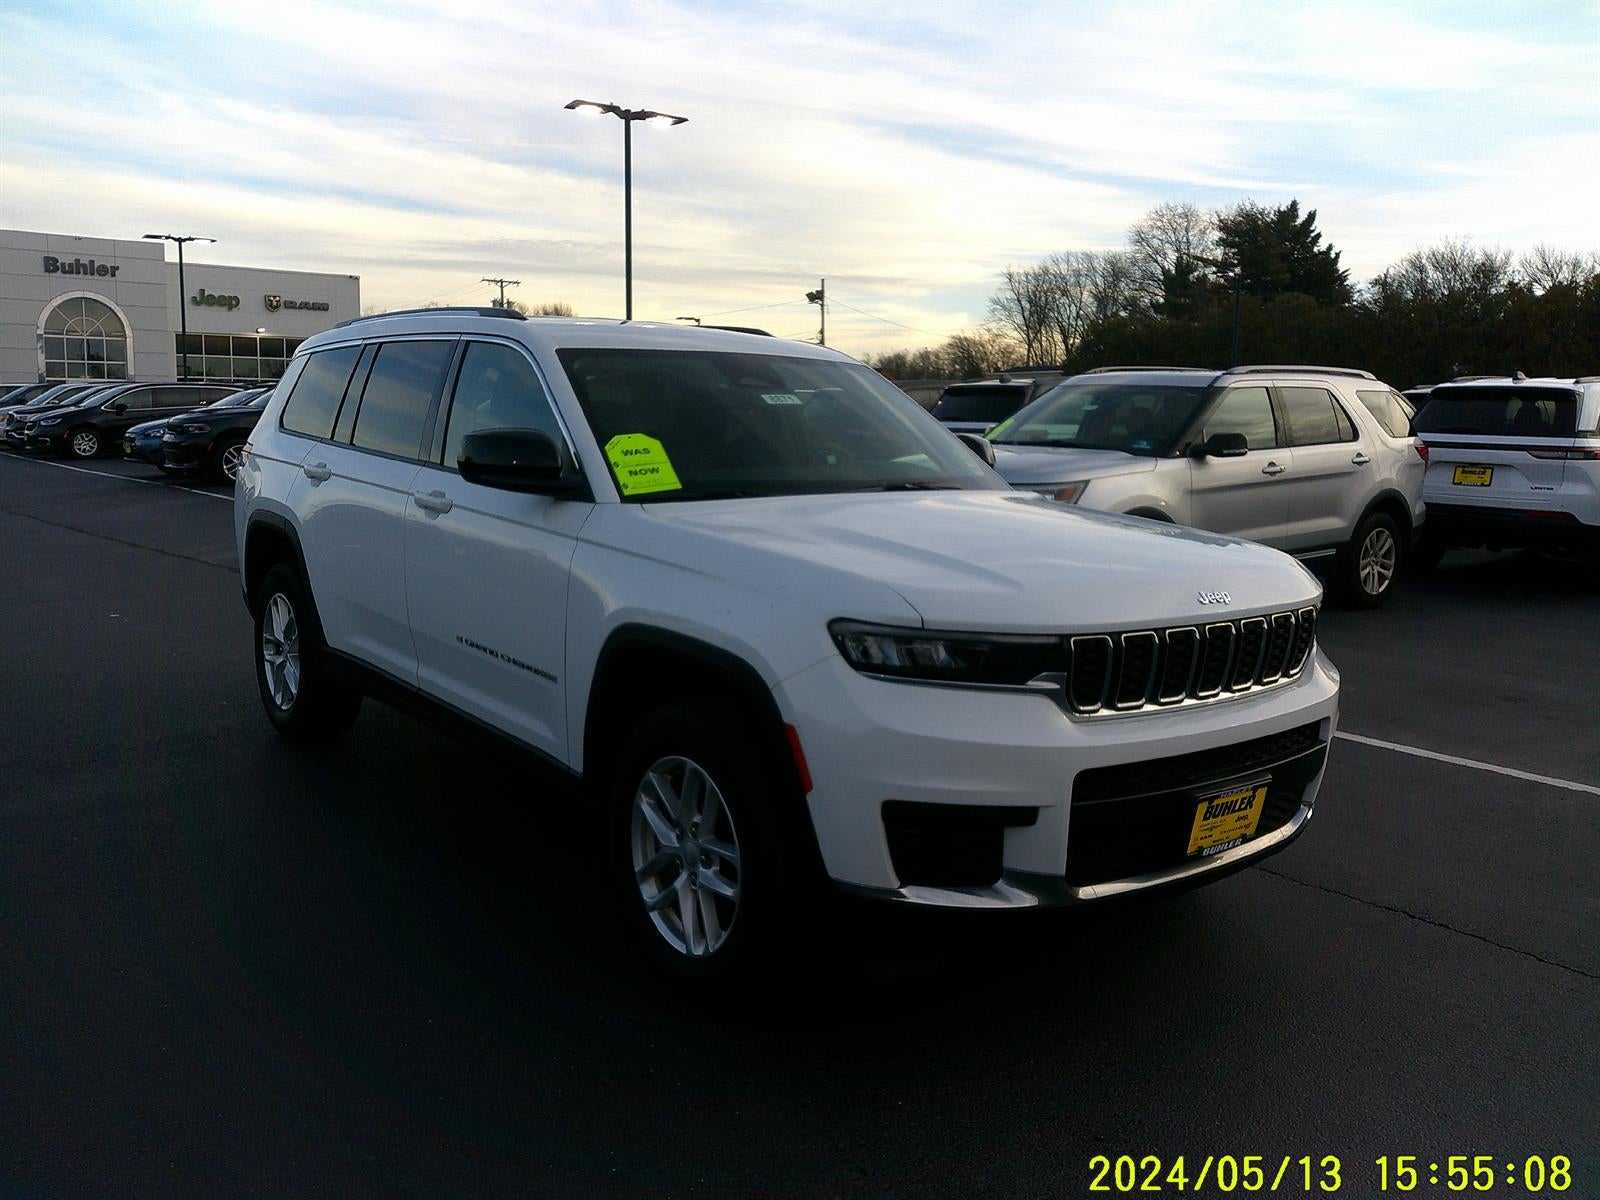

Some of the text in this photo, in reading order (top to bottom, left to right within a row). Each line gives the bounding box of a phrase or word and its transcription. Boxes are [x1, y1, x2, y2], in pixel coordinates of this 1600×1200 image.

[43, 255, 120, 277] Buhler
[191, 288, 240, 311] Jeep
[283, 299, 330, 312] RAM
[621, 447, 651, 457] WAS
[628, 466, 660, 477] NOW
[1198, 591, 1232, 605] Jeep
[1202, 794, 1256, 822] BUHLER
[1202, 838, 1243, 857] BUHLER
